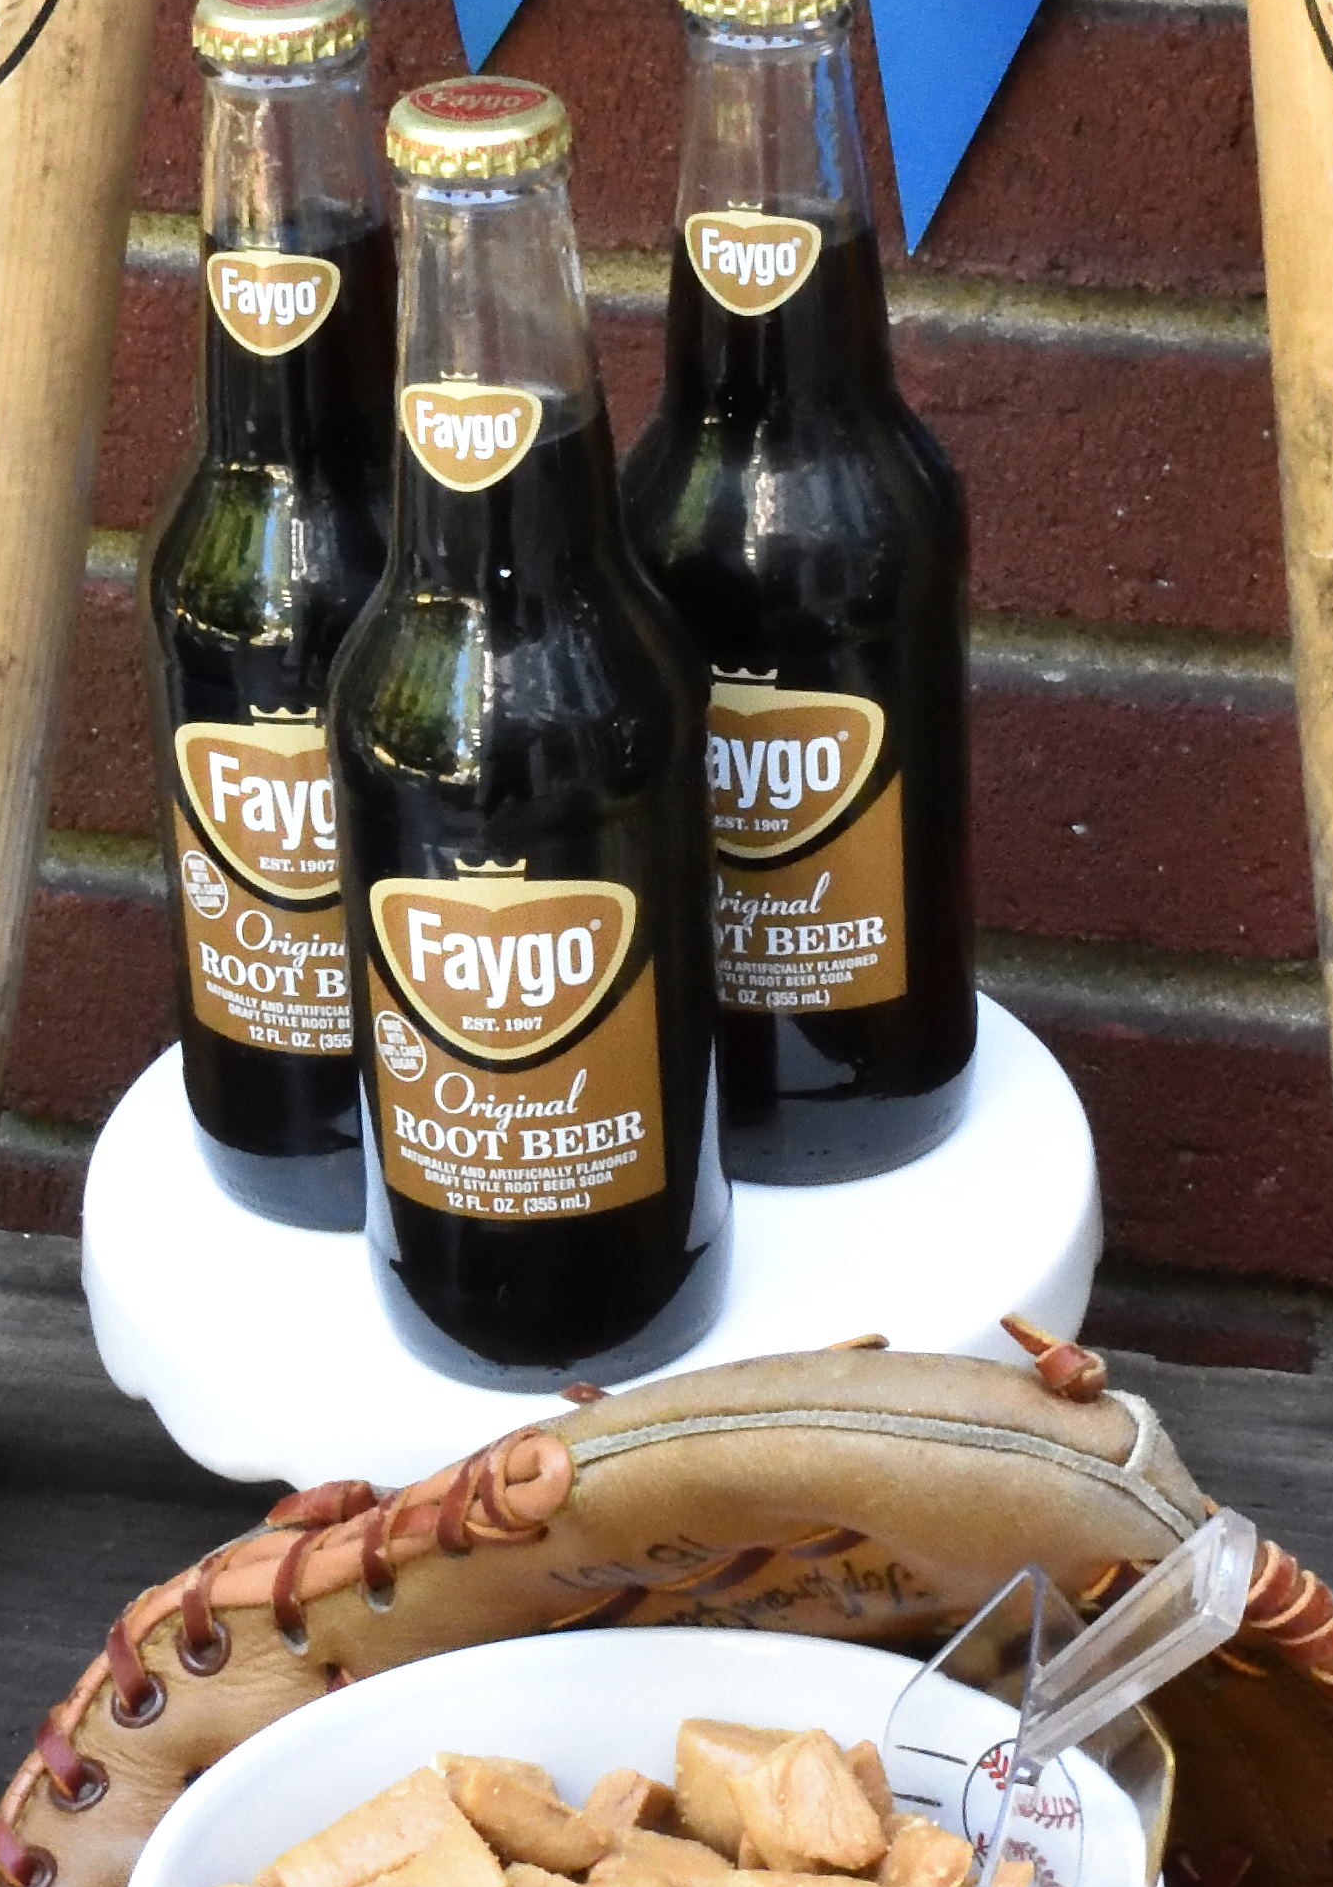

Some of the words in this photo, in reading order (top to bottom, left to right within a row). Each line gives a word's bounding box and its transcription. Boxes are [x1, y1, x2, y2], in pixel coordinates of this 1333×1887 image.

[701, 227, 797, 286] Faygo
[221, 267, 317, 326] Faygo
[415, 399, 517, 460] Faygo
[754, 818, 790, 832] 1907
[260, 855, 295, 872] EST.
[300, 859, 336, 873] 1907
[765, 916, 888, 956] BEER
[199, 941, 304, 997] ROOT
[407, 907, 594, 1009] Faygo
[735, 961, 814, 975] ARTIFICIALLY
[817, 953, 879, 972] FLAVORED
[749, 973, 782, 987] ROOT
[785, 974, 817, 987] BEER
[819, 971, 854, 985] SODA
[261, 999, 284, 1015] AND
[766, 990, 799, 1008] (355
[801, 989, 831, 1007] mL)
[228, 1002, 261, 1022] DRAFT
[265, 1013, 299, 1028] STYLE
[302, 1016, 334, 1030] ROOT
[461, 1014, 500, 1032] EST.
[505, 1016, 543, 1032] 1907
[248, 1024, 266, 1042] 12
[267, 1027, 288, 1046] FL.
[292, 1031, 315, 1049] OZ.
[319, 1033, 353, 1053] (355
[434, 1068, 588, 1131] Original
[392, 1105, 508, 1161] ROOT
[519, 1110, 647, 1161] BEER
[400, 1145, 458, 1175] NATURALLY
[460, 1162, 486, 1180] AND
[489, 1165, 574, 1181] ARTIFICIALLY
[576, 1149, 638, 1174] FLAVORED
[424, 1169, 460, 1188] DRAFT
[463, 1177, 500, 1194] STYLE
[504, 1179, 540, 1194] ROOT
[543, 1175, 576, 1193] BEER
[579, 1170, 614, 1188] SODA
[446, 1190, 464, 1208] 12
[467, 1193, 490, 1212] FL.
[493, 1195, 519, 1213] OZ.
[523, 1195, 558, 1216] (355
[560, 1192, 591, 1211] mL)
